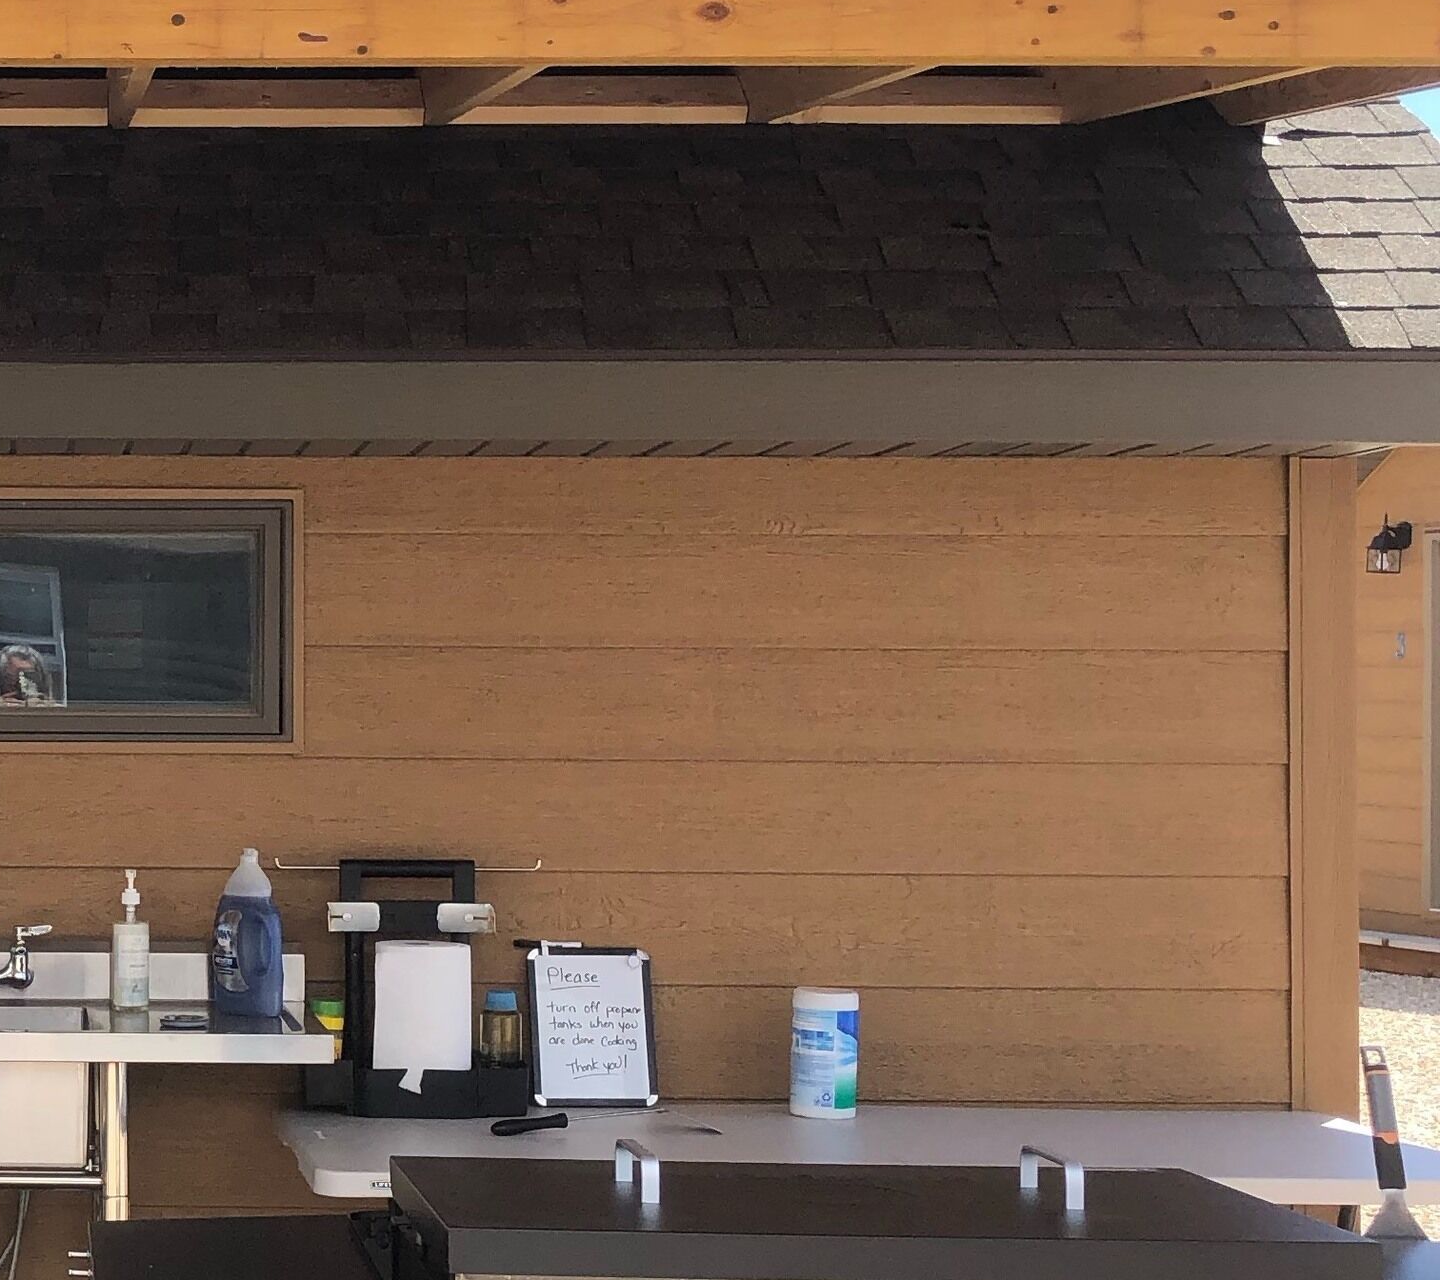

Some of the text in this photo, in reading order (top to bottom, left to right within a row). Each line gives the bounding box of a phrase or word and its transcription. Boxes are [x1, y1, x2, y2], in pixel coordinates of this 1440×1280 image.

[547, 967, 600, 985] Please
[546, 1001, 577, 1013] turn
[583, 1001, 601, 1013] off
[548, 1016, 639, 1033] tanks when you
[548, 1036, 566, 1045] are
[572, 1033, 595, 1045] done
